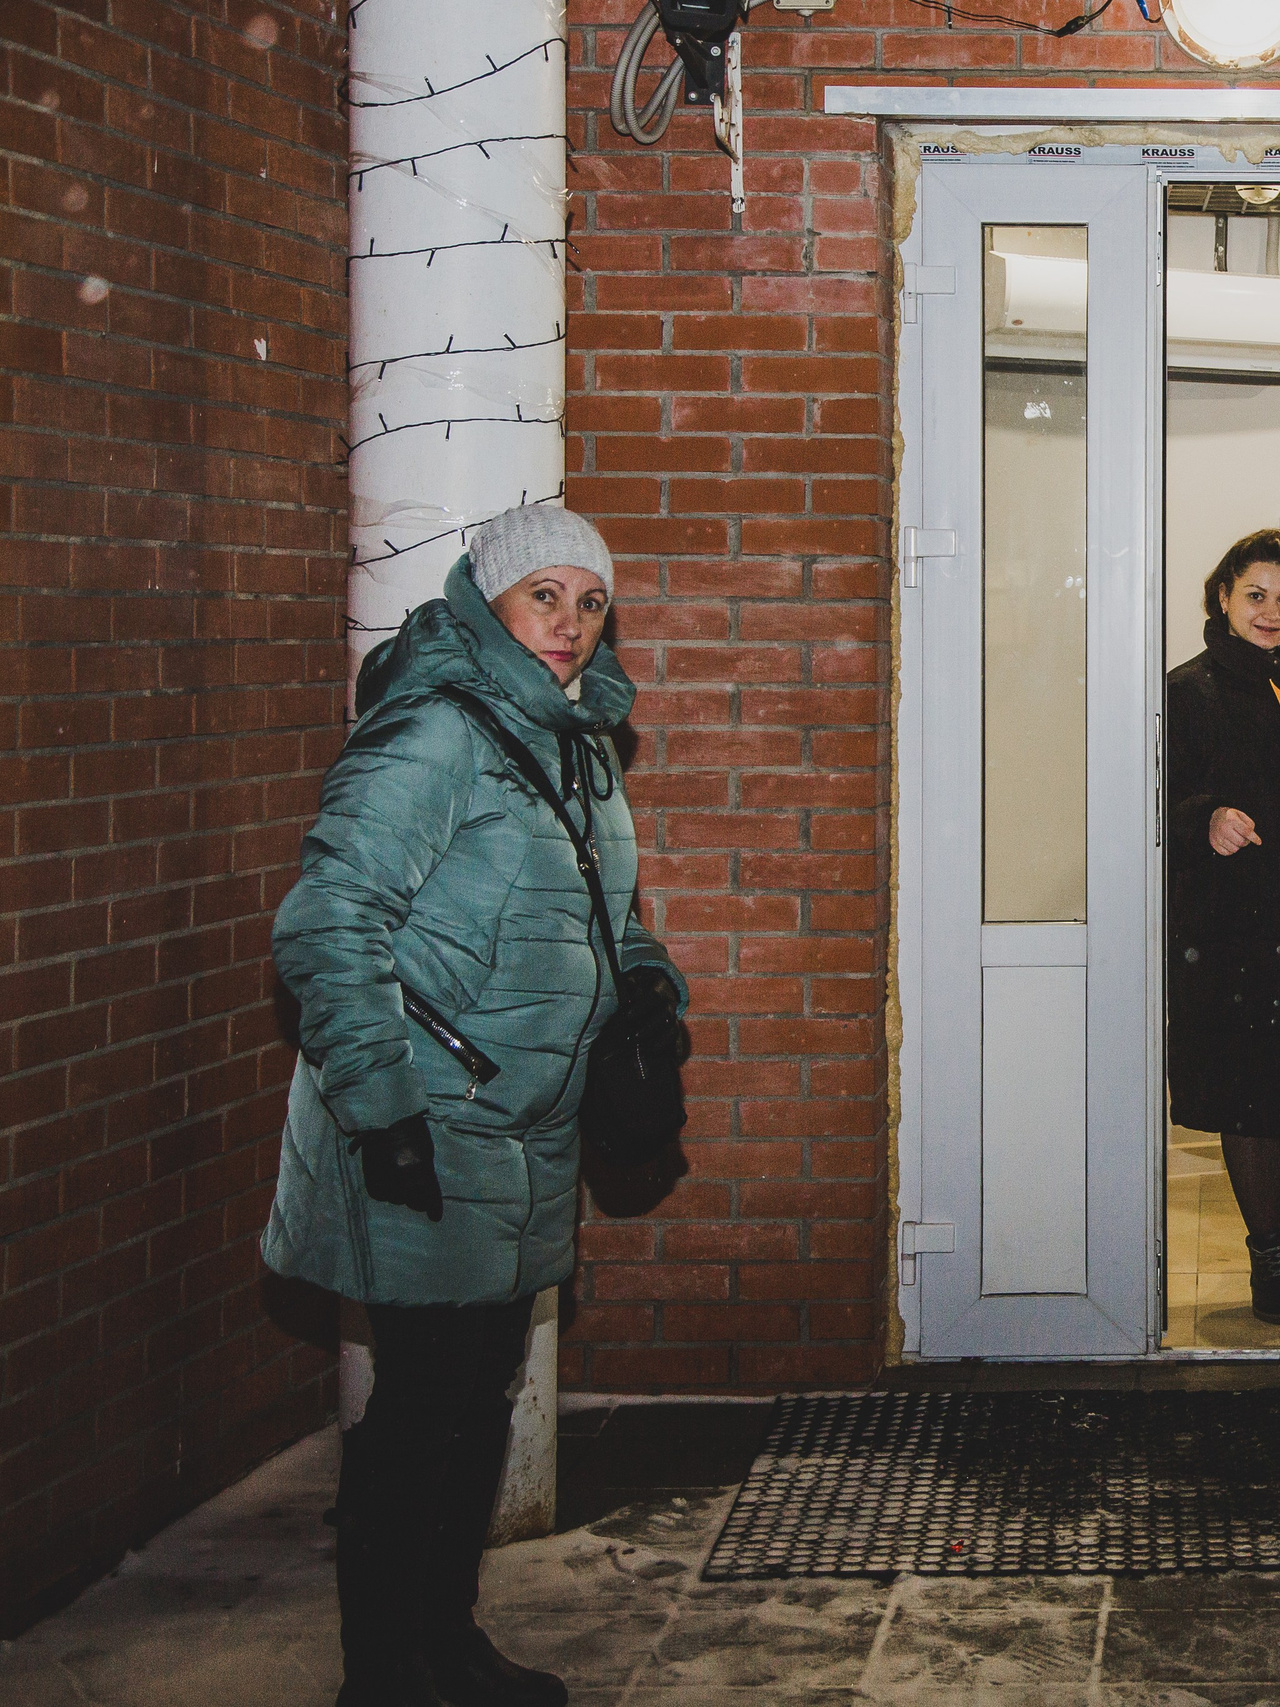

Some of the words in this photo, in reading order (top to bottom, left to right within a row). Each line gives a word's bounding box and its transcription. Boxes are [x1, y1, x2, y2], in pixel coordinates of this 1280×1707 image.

[919, 145, 965, 153] RAUS
[1028, 146, 1082, 155] KRAUSS
[1141, 148, 1195, 156] KRAUSS
